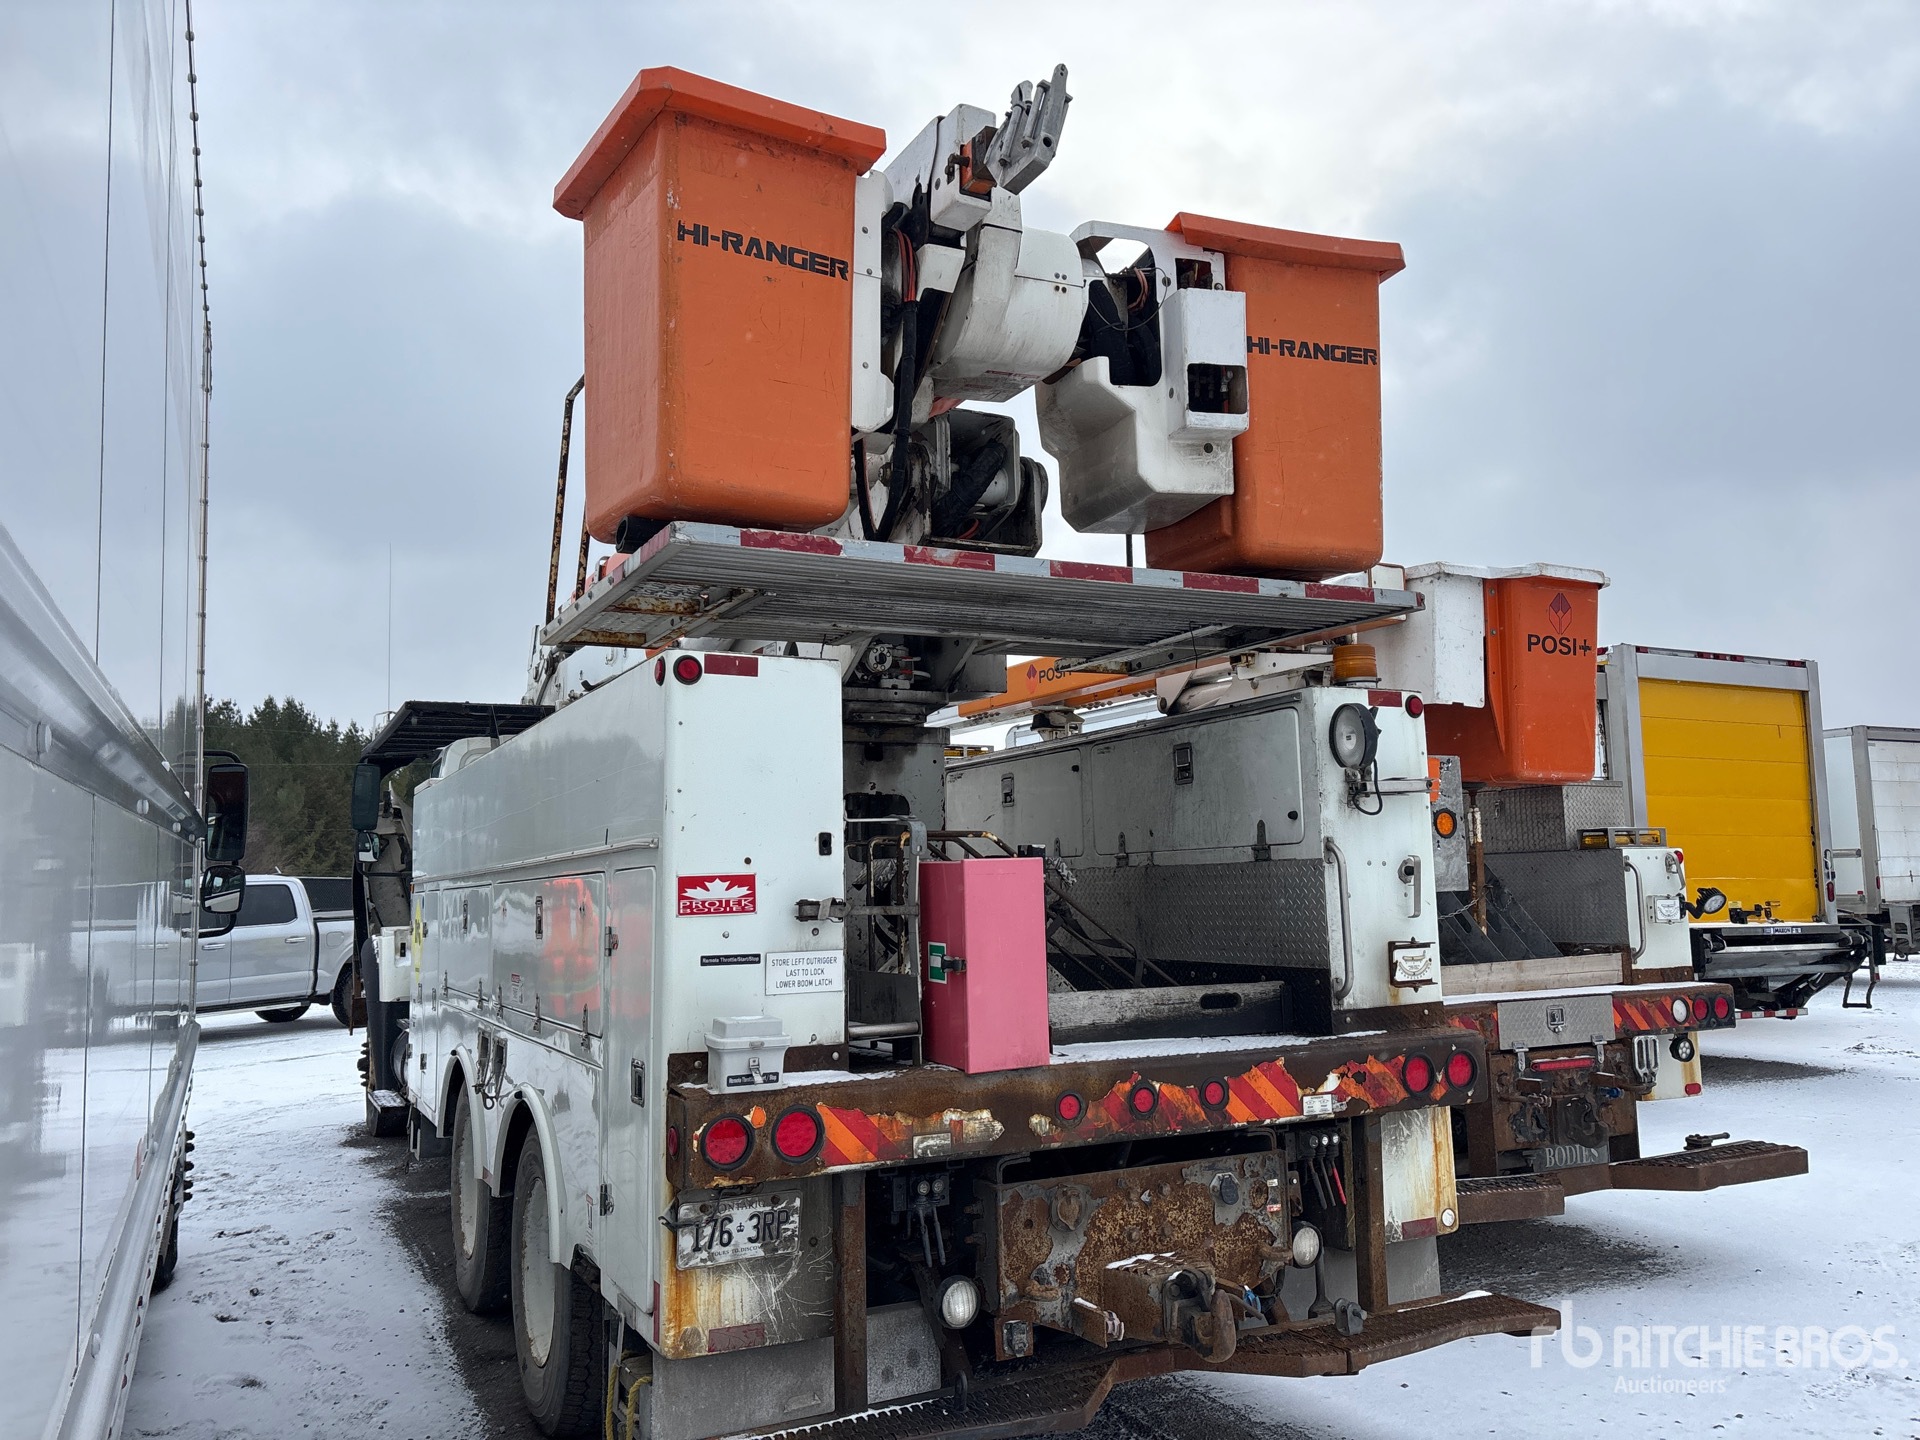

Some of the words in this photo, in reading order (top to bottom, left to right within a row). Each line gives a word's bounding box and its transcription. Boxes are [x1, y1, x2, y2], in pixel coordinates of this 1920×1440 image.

[677, 220, 849, 281] HI-RANGER
[1247, 336, 1378, 365] HI-RANGER
[680, 905, 754, 914] BODIES
[771, 958, 790, 967] STORE
[791, 957, 805, 966] LEFT
[806, 956, 838, 965] OUTRIGGER
[785, 969, 800, 977] LAST
[801, 968, 809, 976] TO
[810, 968, 825, 976] LOCK
[775, 980, 796, 989] LOWER
[797, 979, 813, 988] BOOM
[814, 978, 833, 987] LATCH
[692, 1216, 734, 1253] 176
[747, 1210, 789, 1244] 3RP
